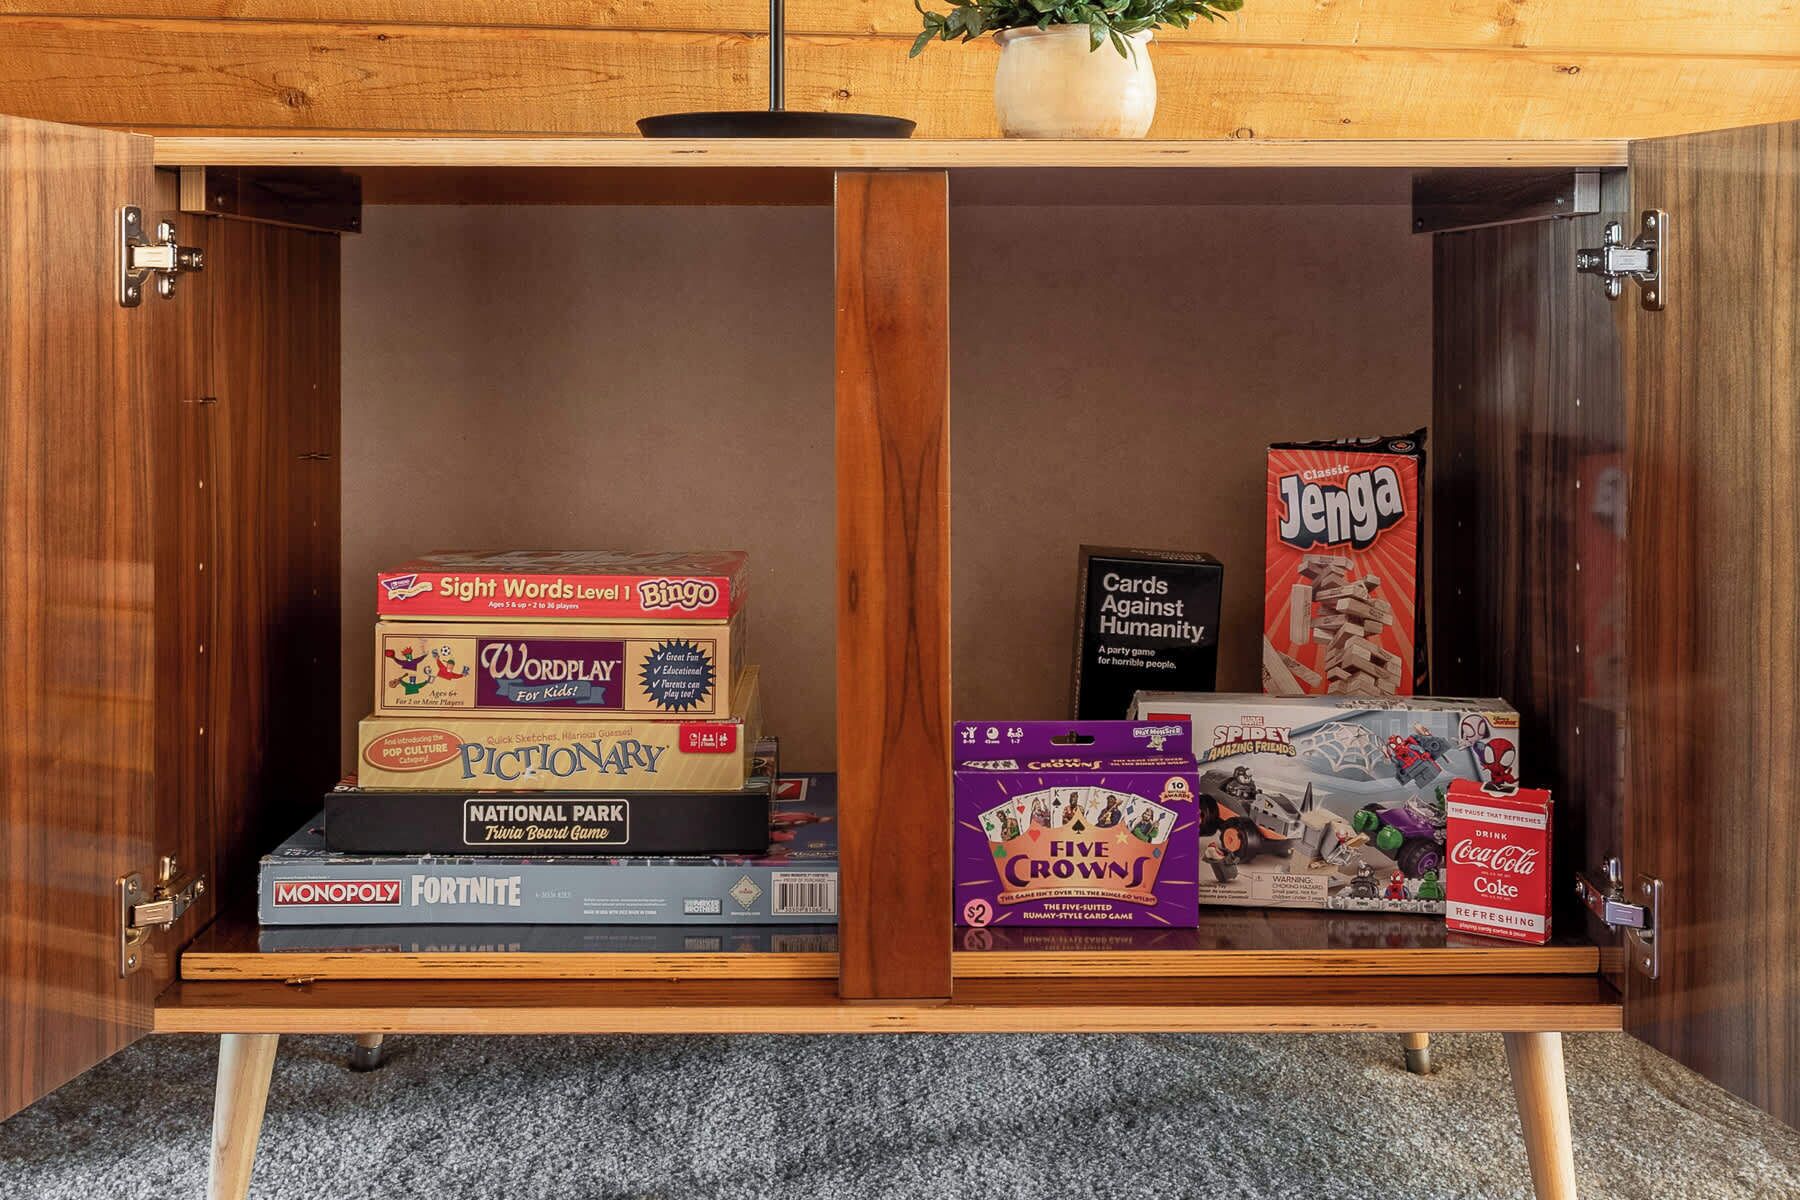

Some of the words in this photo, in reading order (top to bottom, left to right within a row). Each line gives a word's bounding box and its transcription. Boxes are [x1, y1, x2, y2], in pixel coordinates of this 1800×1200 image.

[1303, 465, 1350, 481] Classic
[1279, 466, 1404, 544] Jenga
[439, 576, 498, 602] Sight
[503, 578, 574, 600] Words
[577, 584, 619, 600] Level
[623, 585, 631, 601] 1
[1103, 572, 1169, 595] Cards
[640, 581, 716, 608] Bingo
[488, 601, 504, 609] Ages
[555, 603, 579, 611] players
[1100, 594, 1185, 618] Against
[666, 651, 685, 662] Great
[686, 652, 699, 662] Fun
[1098, 645, 1106, 653] A
[1107, 646, 1130, 656] party
[1131, 648, 1156, 657] game
[662, 665, 703, 676] Educational
[1097, 656, 1111, 665] for
[1111, 657, 1144, 667] horrible
[1145, 660, 1177, 670] people.
[661, 679, 686, 689] Parents
[687, 681, 700, 689] can
[429, 690, 447, 698] Ages
[516, 690, 540, 702] For
[543, 683, 579, 699] Kids!
[663, 688, 680, 700] play
[440, 699, 465, 707] Players
[487, 735, 513, 745] Quick
[562, 730, 597, 741] Hilarious
[1213, 725, 1292, 747] SPIDEY
[382, 747, 402, 757] POP
[404, 743, 448, 755] CULTURE
[1207, 741, 1254, 761] AMAZING
[1254, 740, 1297, 757] FRIENDS
[457, 738, 666, 782] PICTIONARY
[1027, 760, 1103, 770] CROWNS
[1053, 789, 1060, 797] K
[1171, 782, 1184, 790] 10
[470, 804, 567, 822] NATIONAL
[572, 804, 624, 822] PARK
[1464, 809, 1484, 817] PAUSE
[1486, 812, 1502, 820] THAT
[1503, 814, 1541, 825] REFRESHES
[485, 825, 524, 841] Trivia
[526, 825, 569, 841] Board
[570, 825, 608, 841] Game
[1475, 829, 1508, 840] DRINK
[1050, 841, 1109, 857] FIVE
[1450, 838, 1540, 875] Coca-Cola
[1004, 854, 1151, 888] CROWNS
[1272, 875, 1313, 884] WARNING:
[1473, 876, 1519, 898] Coke
[277, 883, 399, 903] MONOPOLY
[411, 874, 521, 907] FORTNITE
[967, 903, 986, 924] $2
[1043, 903, 1060, 911] THE
[1061, 903, 1113, 911] FIVE-SUITED
[1023, 912, 1081, 920] RUMMY-STYLE
[1083, 912, 1108, 920] CARD
[1108, 912, 1133, 920] GAME
[1455, 907, 1535, 927] REFRESHING
[1459, 923, 1478, 931] playing
